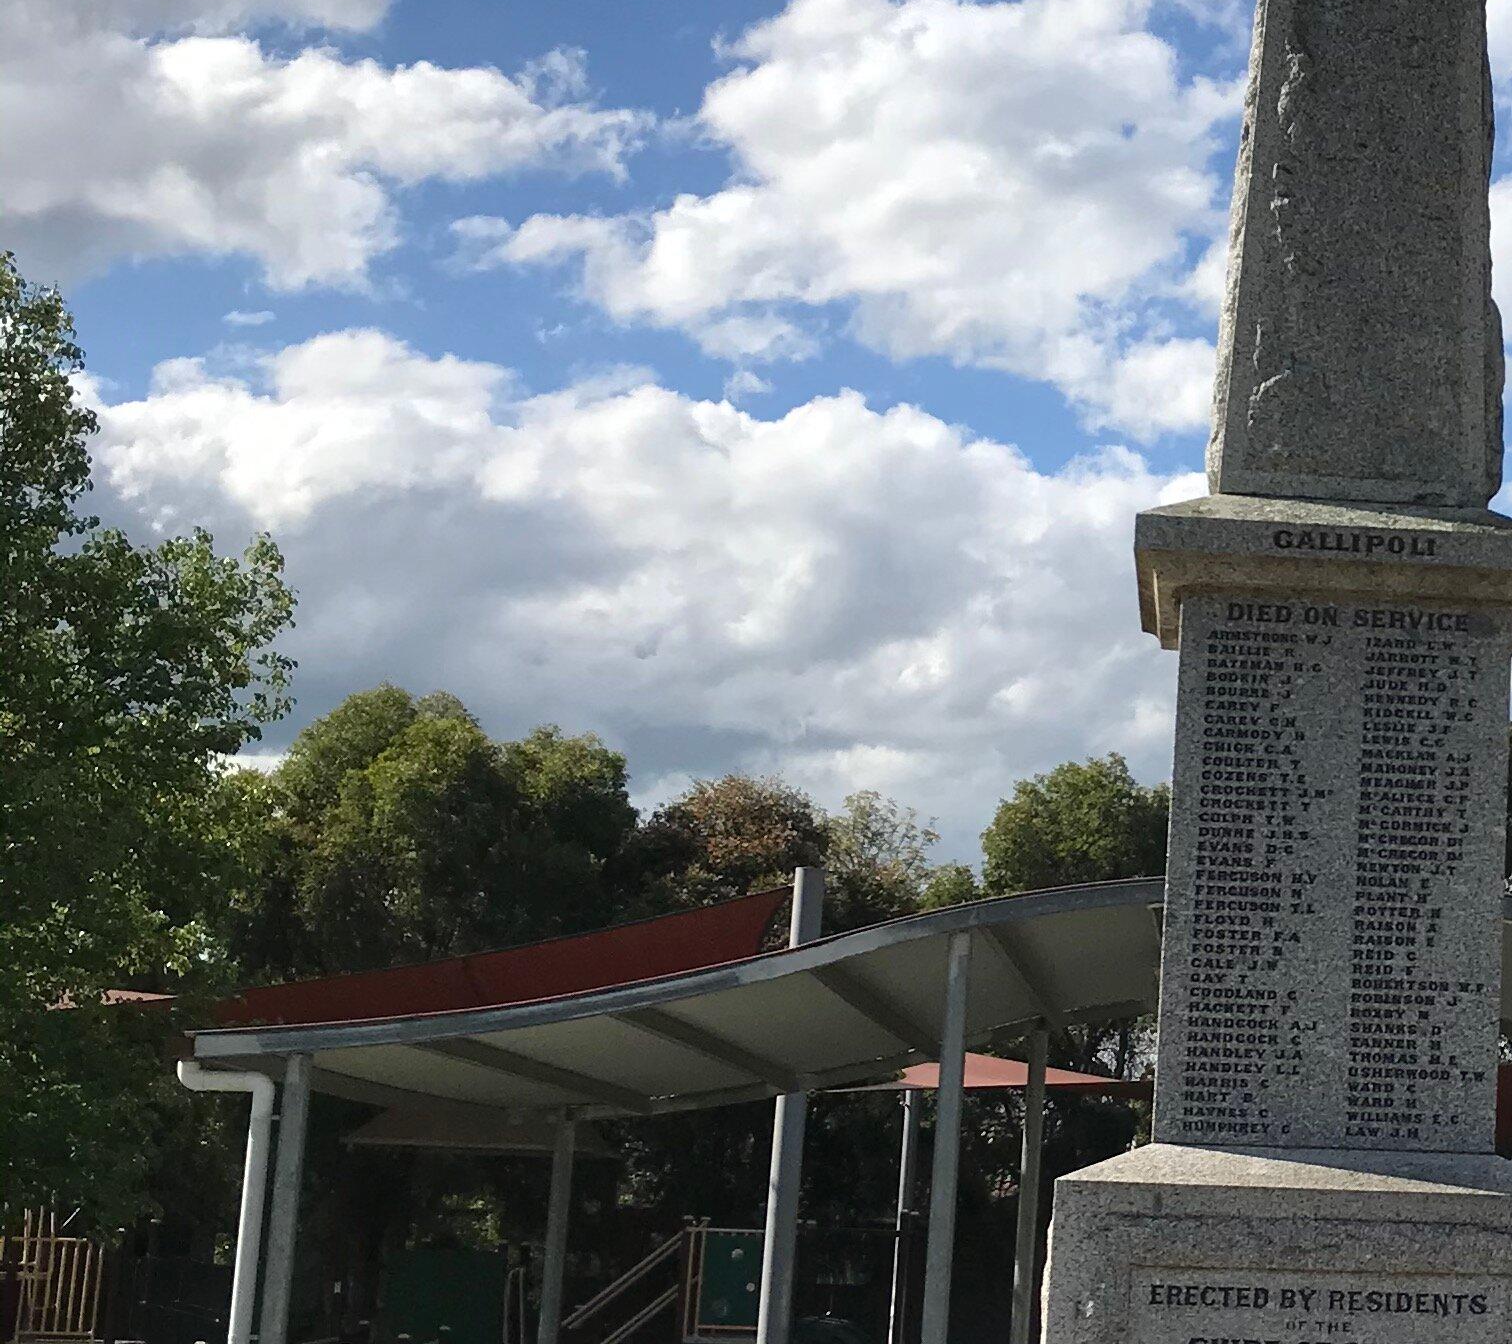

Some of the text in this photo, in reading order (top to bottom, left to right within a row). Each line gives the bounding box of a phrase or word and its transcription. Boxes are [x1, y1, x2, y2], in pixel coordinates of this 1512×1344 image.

[1273, 530, 1437, 556] GALLIPOLI
[1227, 602, 1468, 632] DIED ON SERVICE
[1208, 644, 1270, 656] BAILLIE
[1208, 659, 1284, 670] BATEMAN
[1207, 672, 1269, 684] BODKIN
[1364, 666, 1439, 678] JEFFREY
[1363, 680, 1407, 691] JUDE
[1205, 700, 1260, 712] CAREY
[1364, 694, 1439, 706] KENNEDY
[1204, 714, 1261, 726] CAREY
[1363, 722, 1415, 733] LESLIE
[1203, 728, 1284, 740] CARMODY
[1363, 735, 1410, 746] LEWIS
[1202, 756, 1279, 769] COULTER
[1361, 763, 1438, 776] MAHONEY
[1201, 770, 1267, 782] COZENS
[1200, 785, 1290, 797] CROCKETT
[1200, 798, 1290, 810] CROCKETT
[1197, 841, 1254, 853] EVANS
[1197, 855, 1252, 867] EVANS
[1356, 862, 1420, 874] NEWTON
[1196, 869, 1282, 883] FERGUSON
[1356, 876, 1408, 888] NOLAN
[1195, 885, 1281, 898] FERGUSON
[1355, 891, 1407, 903] PLANT
[1194, 900, 1281, 912] FERGUSON
[1354, 906, 1420, 918] POTTER
[1193, 914, 1251, 926] FLOYD
[1354, 920, 1417, 932] RAISON
[1193, 929, 1261, 941] FOSTER
[1192, 943, 1260, 956] FOSTER
[1353, 949, 1394, 961] REID
[1353, 964, 1393, 975] REID
[1351, 978, 1449, 991] ROBERTSON
[1351, 993, 1435, 1005] ROBINSON
[1188, 1001, 1271, 1014] HACKETT
[1188, 1016, 1279, 1030] HANDCOCK
[1350, 1022, 1417, 1035] SHANKS
[1187, 1032, 1279, 1044] HANDCOCK
[1350, 1037, 1417, 1049] TANNER
[1187, 1046, 1266, 1059] HANDLEY
[1349, 1051, 1417, 1064] THOMAS
[1185, 1061, 1266, 1073] HANDLEY
[1348, 1066, 1450, 1080] USHERWOOD
[1185, 1077, 1249, 1089] HARRIS
[1347, 1082, 1394, 1092] WARD
[1184, 1091, 1231, 1102] HART
[1347, 1097, 1394, 1107] WARD
[1183, 1107, 1248, 1118] HAYNES
[1346, 1111, 1424, 1124] WILLIAMS
[1182, 1120, 1270, 1134] HUMPHREY
[1345, 1127, 1380, 1136] LAW
[1148, 1284, 1488, 1317] ERECTED BY RESIDENTS
[1286, 1320, 1352, 1334] OF THE
